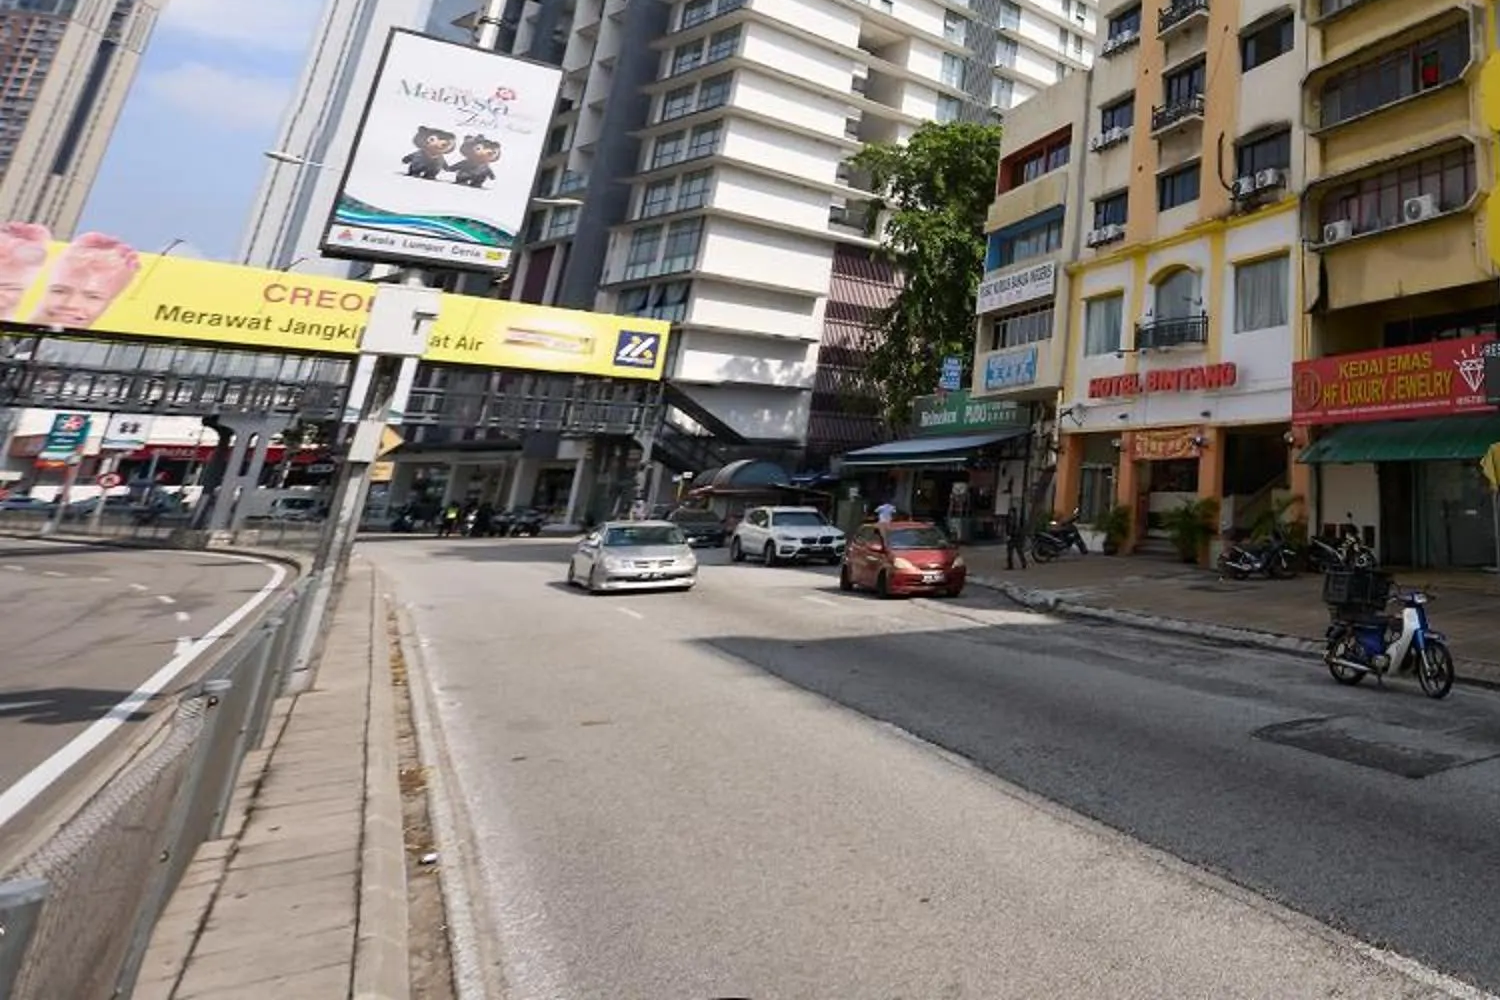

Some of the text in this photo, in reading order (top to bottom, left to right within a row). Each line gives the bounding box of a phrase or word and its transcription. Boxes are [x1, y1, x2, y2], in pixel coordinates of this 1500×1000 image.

[154, 304, 271, 332] Merawat
[455, 335, 485, 351] Air
[1338, 352, 1432, 379] KEDAI EMAS
[1088, 373, 1143, 399] HOTEL
[1340, 376, 1388, 405] LUXURY
[1390, 370, 1453, 399] JEWELRY
